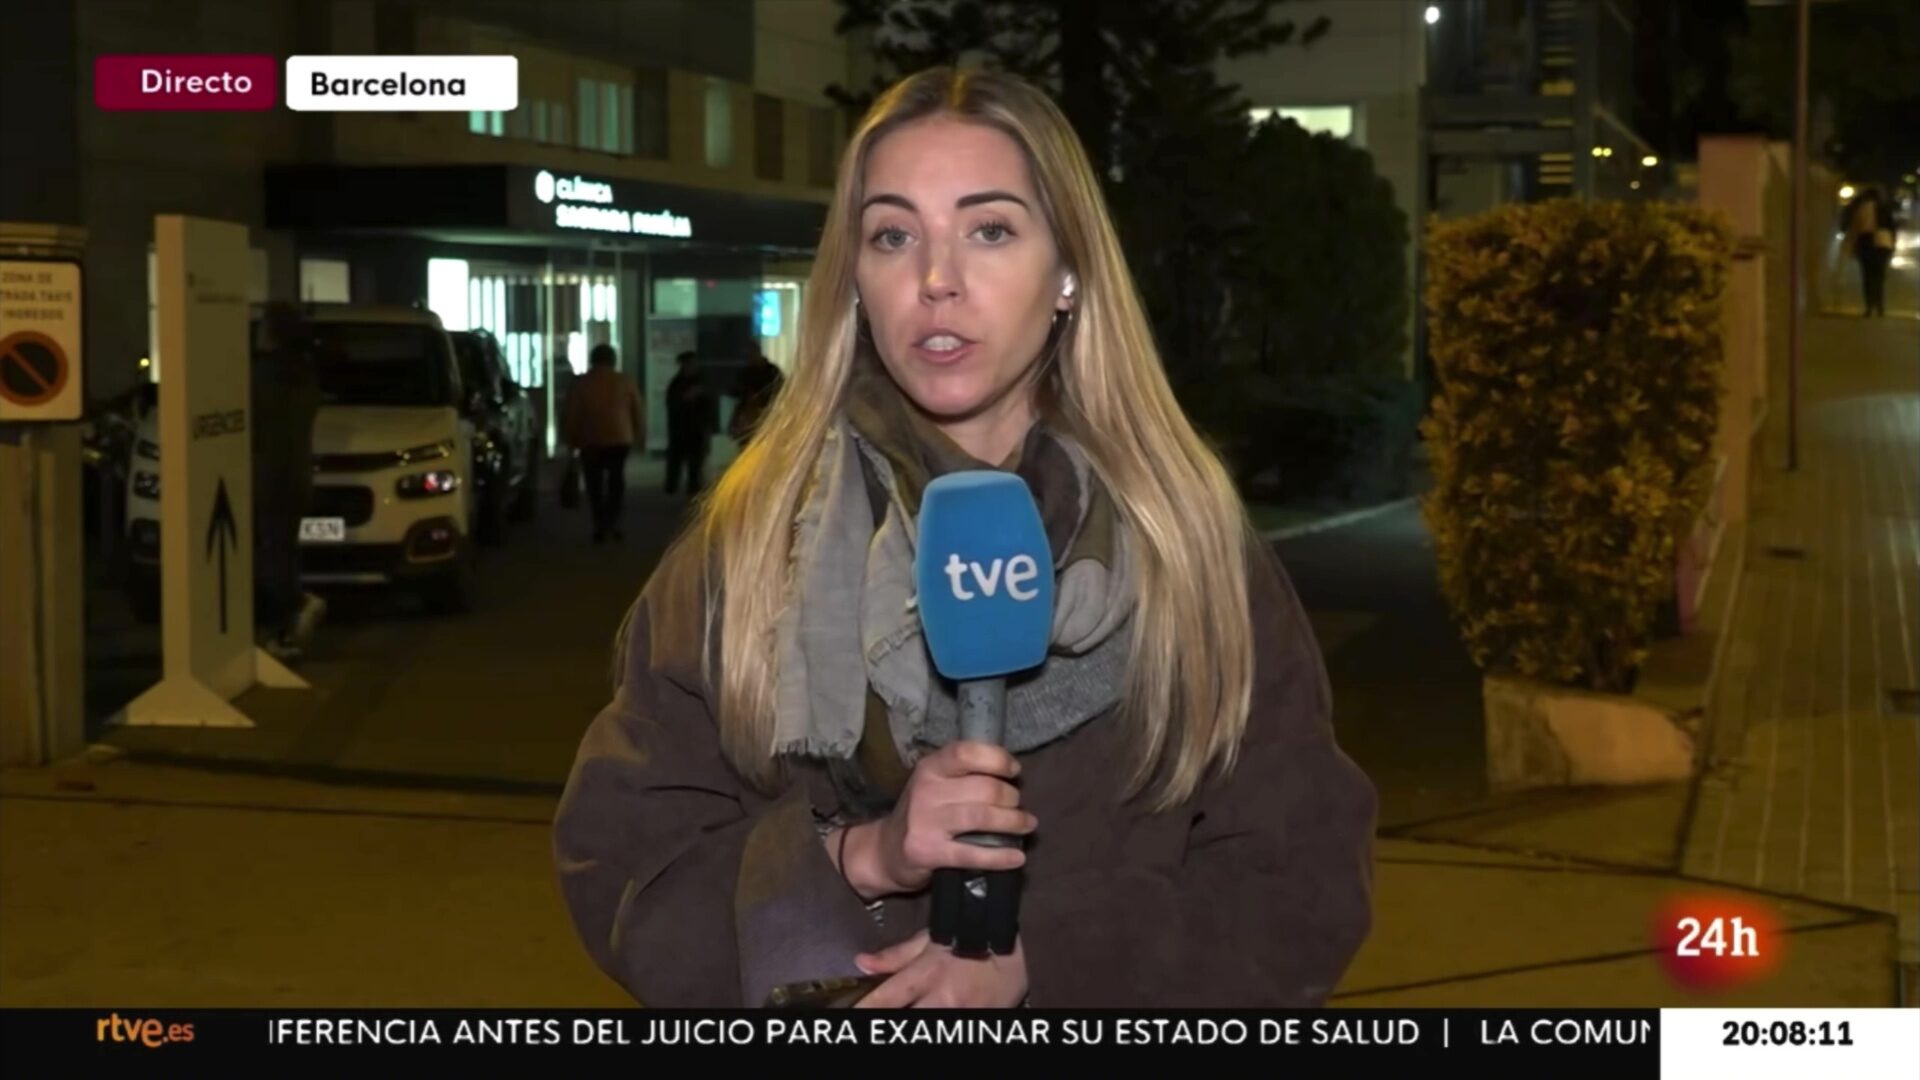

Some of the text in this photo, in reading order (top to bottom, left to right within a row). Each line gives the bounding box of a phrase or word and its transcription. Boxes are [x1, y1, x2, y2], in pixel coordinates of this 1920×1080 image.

[3, 271, 53, 284] ZONA DE
[945, 554, 1038, 603] tve
